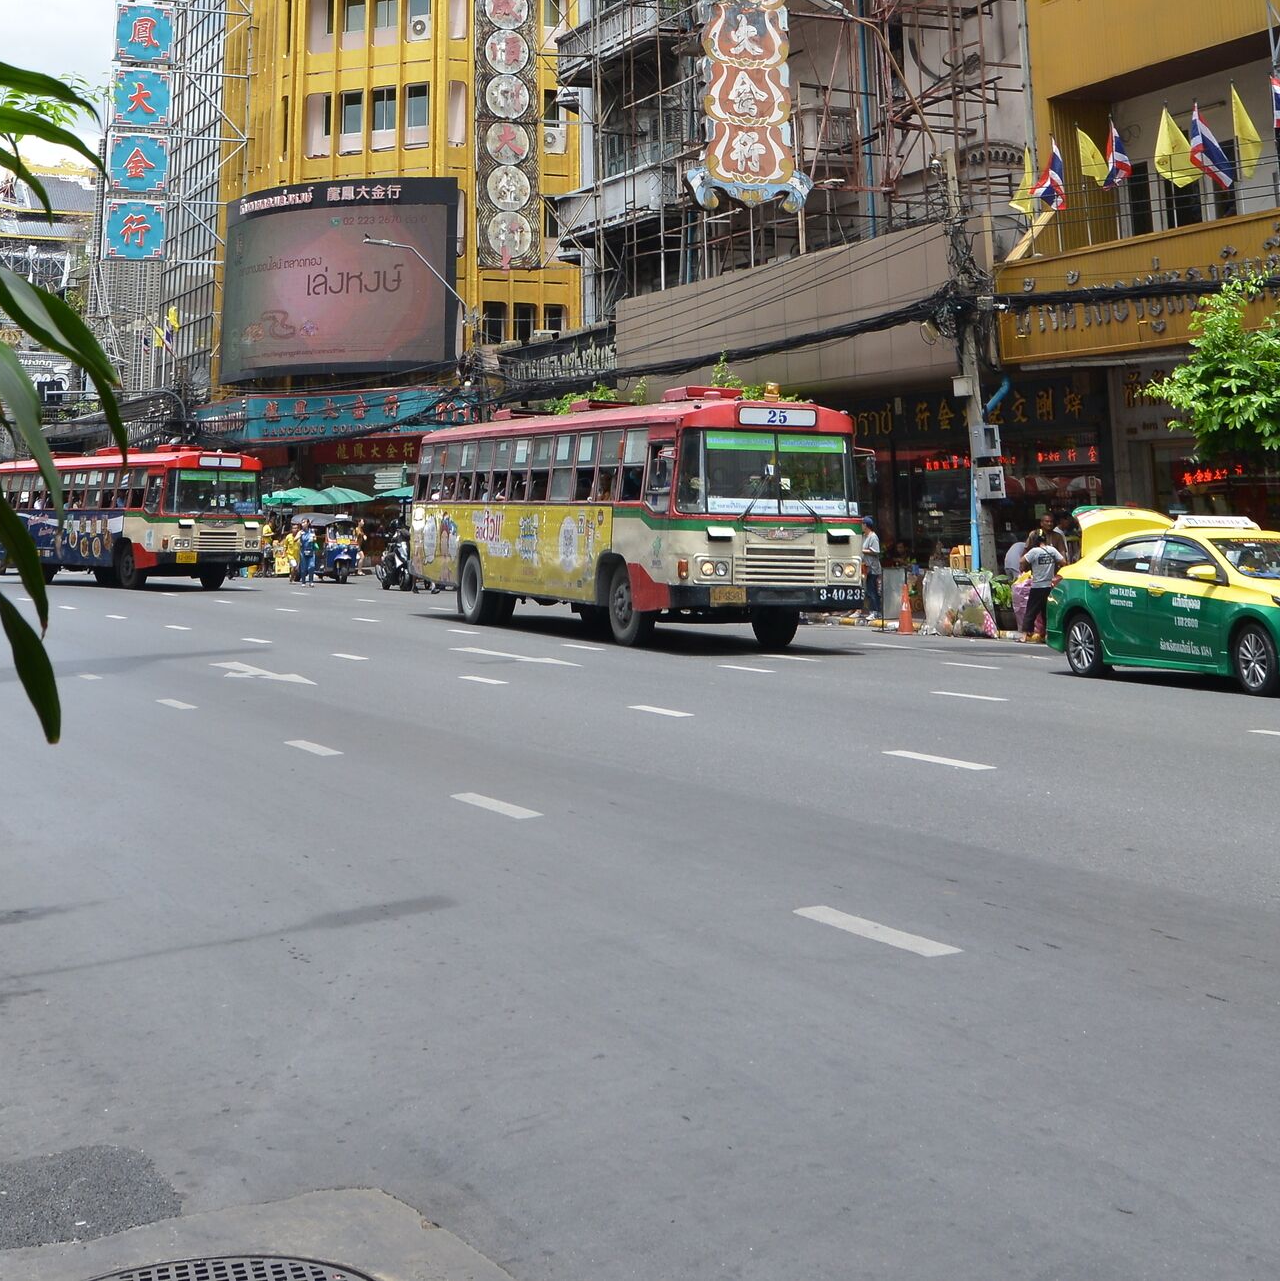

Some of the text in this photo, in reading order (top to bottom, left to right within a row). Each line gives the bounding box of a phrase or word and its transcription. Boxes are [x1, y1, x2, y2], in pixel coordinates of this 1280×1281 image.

[327, 184, 402, 202] 龍鳳大金行
[306, 263, 404, 297] เล่งหงษ์
[766, 409, 788, 425] 25
